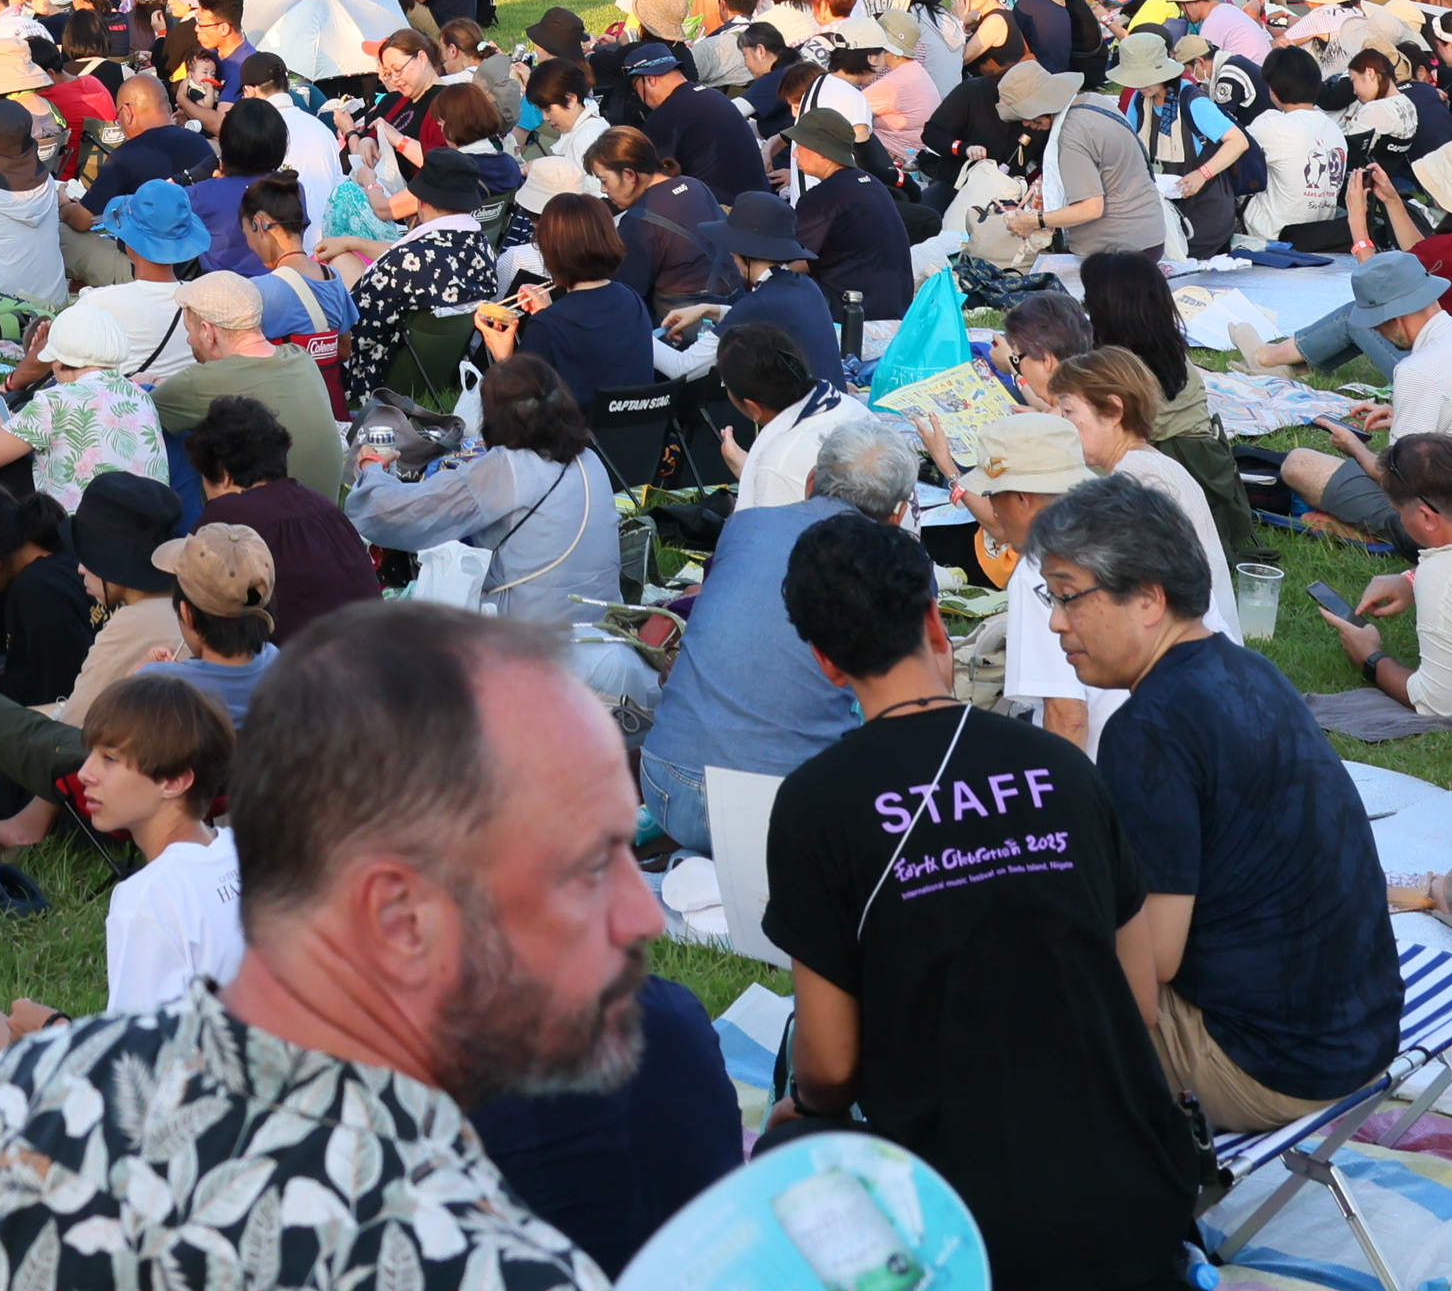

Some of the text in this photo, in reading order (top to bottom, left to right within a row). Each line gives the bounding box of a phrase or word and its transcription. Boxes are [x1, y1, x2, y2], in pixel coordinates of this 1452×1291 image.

[609, 398, 649, 413] CAPTAIN
[874, 768, 1054, 835] STAFF
[893, 831, 1069, 882] Earth Celebration 2025
[902, 883, 945, 900] International
[946, 877, 967, 888] music
[968, 871, 994, 885] festival
